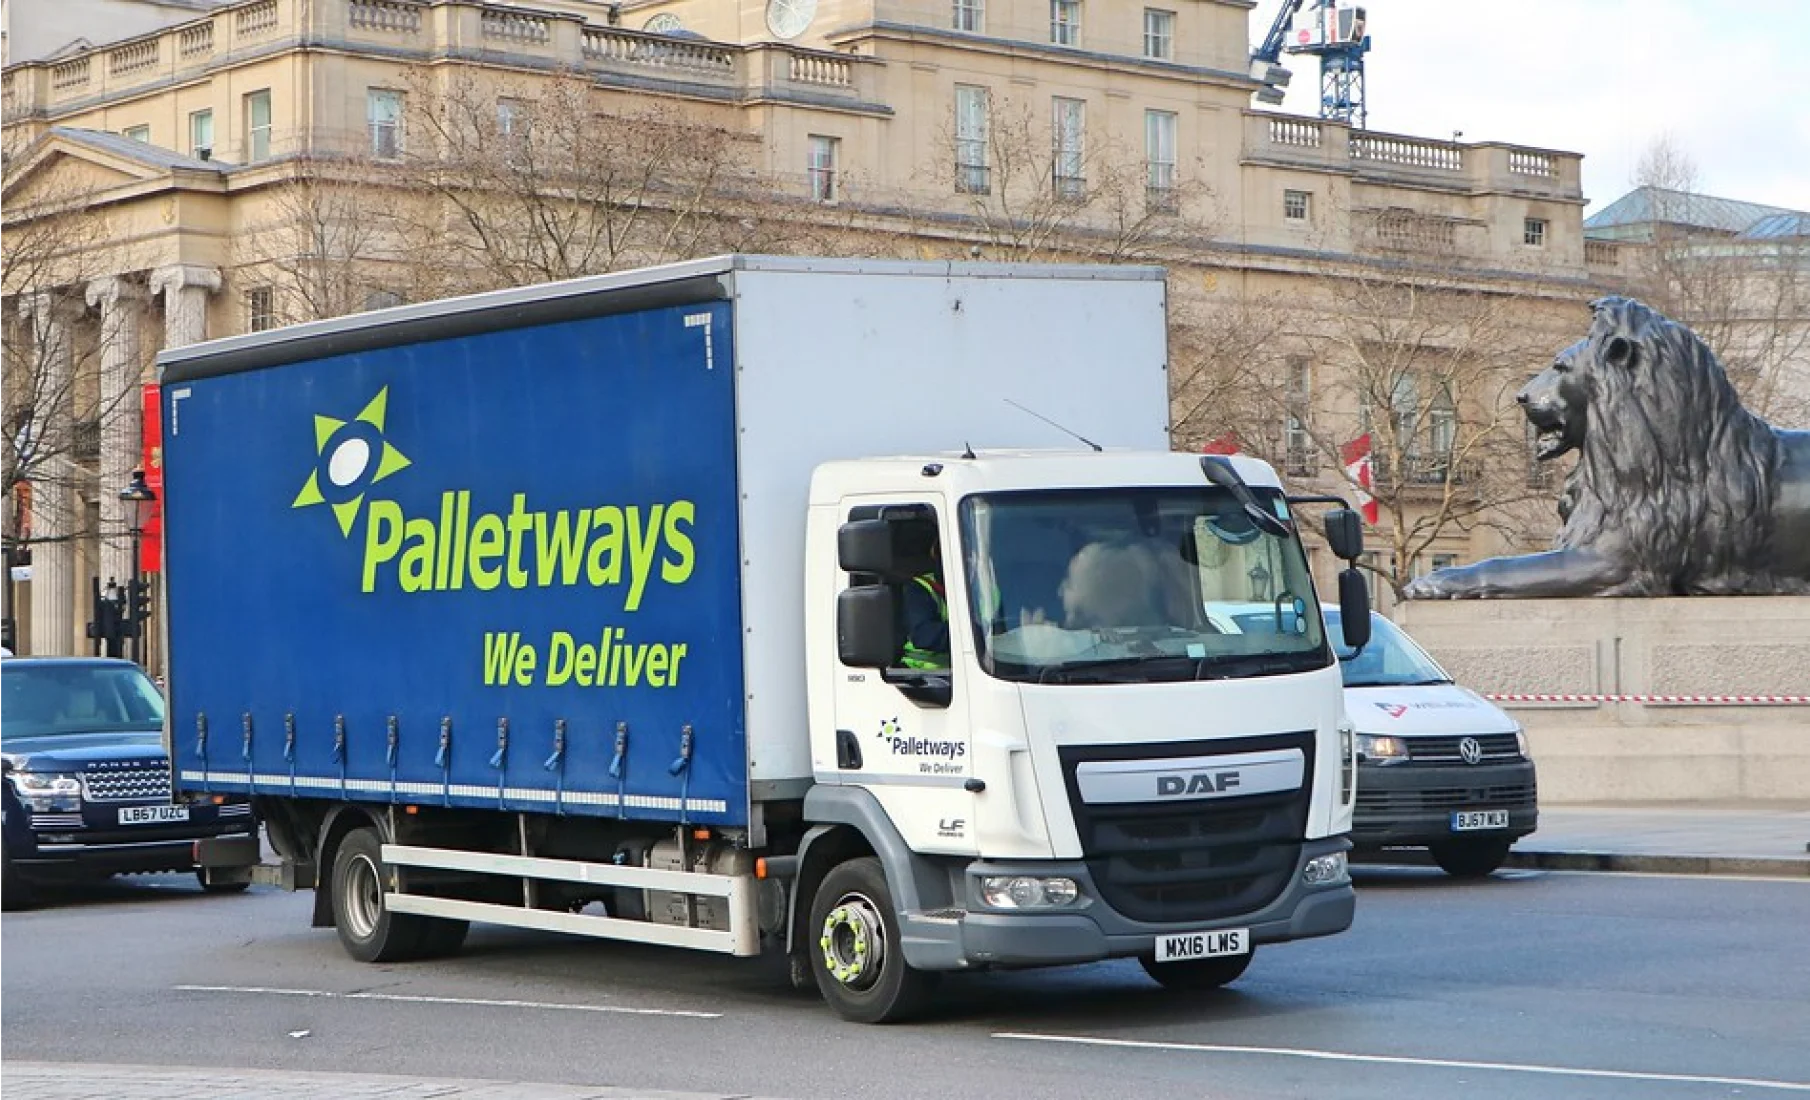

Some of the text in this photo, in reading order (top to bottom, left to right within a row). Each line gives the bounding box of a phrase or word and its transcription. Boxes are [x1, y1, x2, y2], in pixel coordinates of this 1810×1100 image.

[362, 490, 696, 611] Palletways
[484, 626, 687, 687] We Deliver
[892, 737, 965, 760] Palletways
[934, 763, 963, 774] Deliver
[1157, 771, 1240, 796] DAF
[939, 819, 965, 831] LF
[1166, 936, 1204, 958] MX16
